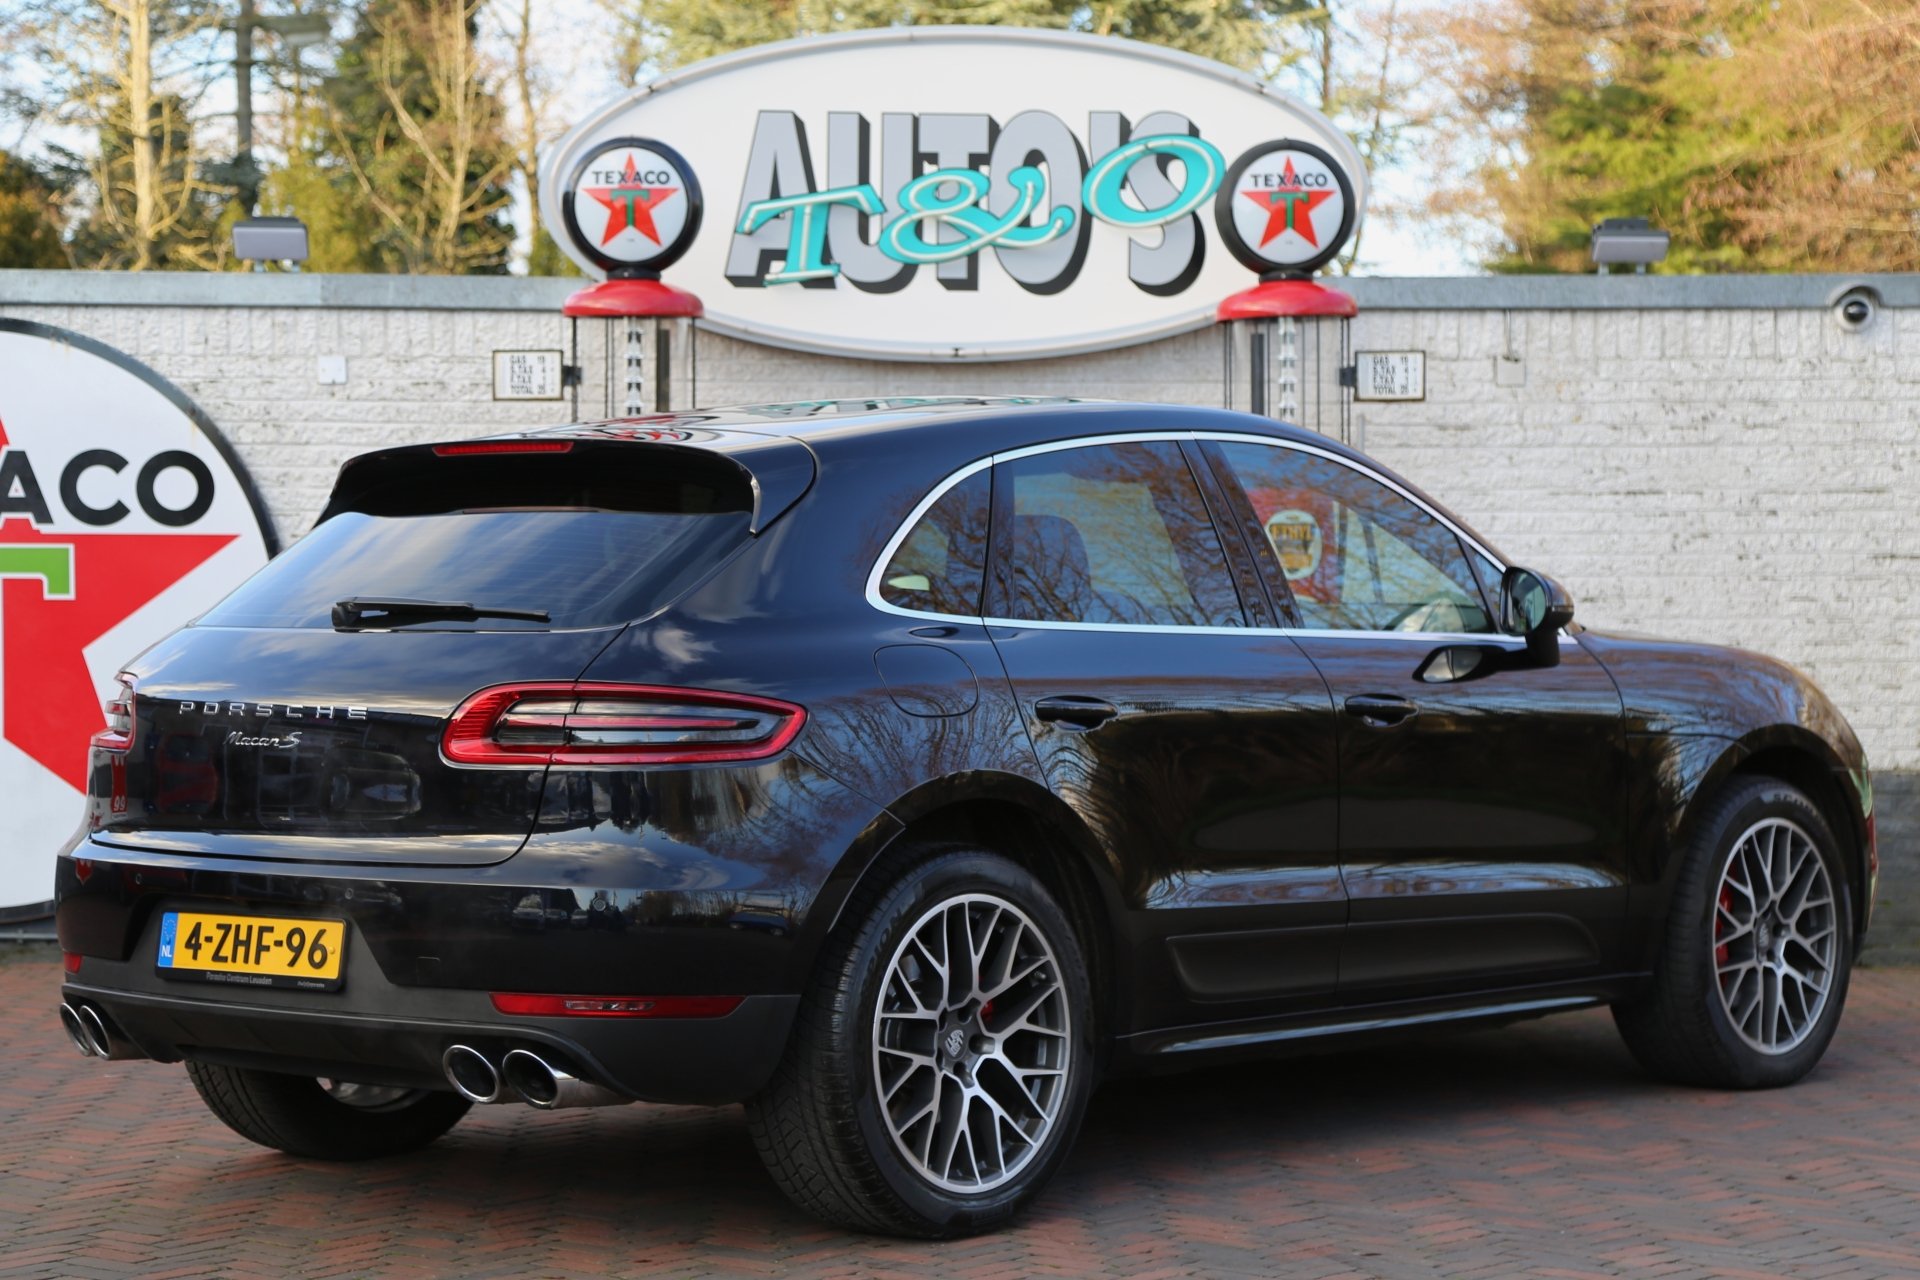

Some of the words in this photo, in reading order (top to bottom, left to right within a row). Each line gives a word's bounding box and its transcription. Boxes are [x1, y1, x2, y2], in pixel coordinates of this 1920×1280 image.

[591, 171, 671, 185] TEXACO
[1250, 173, 1329, 187] TEXACO
[179, 701, 369, 720] PORSCHE
[223, 731, 281, 746] Macan
[277, 731, 303, 749] S
[161, 945, 173, 958] NL
[183, 921, 329, 970] 4-ZHF-96
